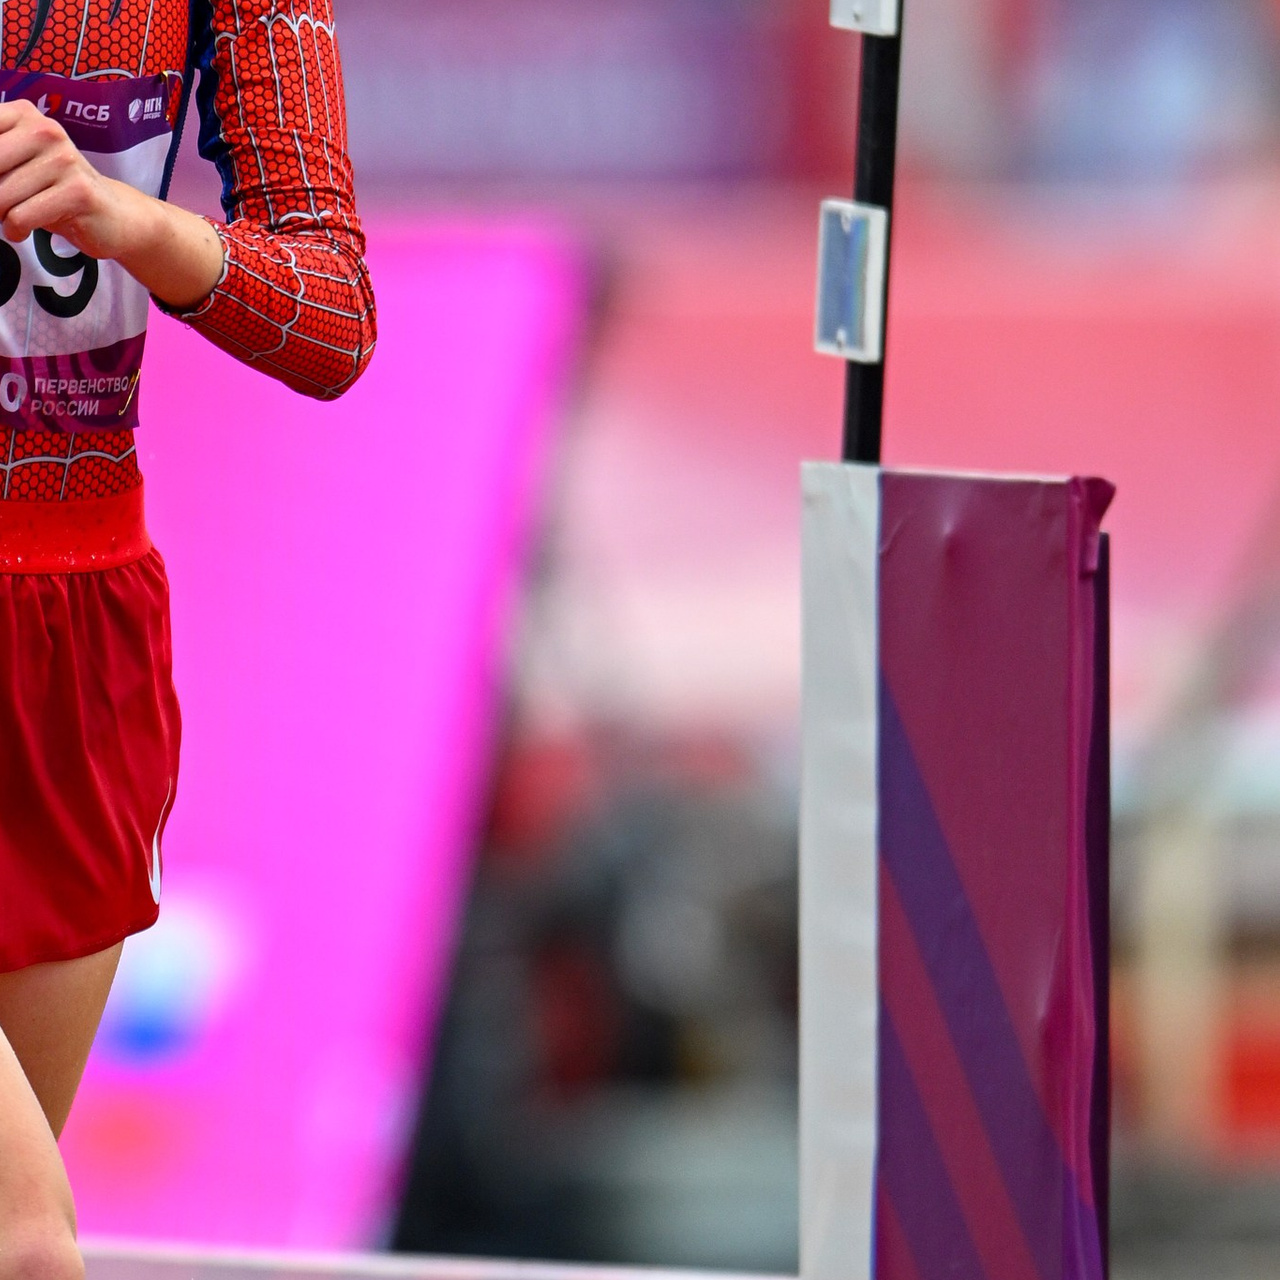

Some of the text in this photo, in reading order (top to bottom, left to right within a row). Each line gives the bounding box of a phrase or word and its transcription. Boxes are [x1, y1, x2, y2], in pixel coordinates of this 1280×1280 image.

[64, 100, 110, 122] ПСБ
[34, 375, 129, 395] ПЕРВЕНСТВО
[30, 399, 100, 416] РОССИИ
